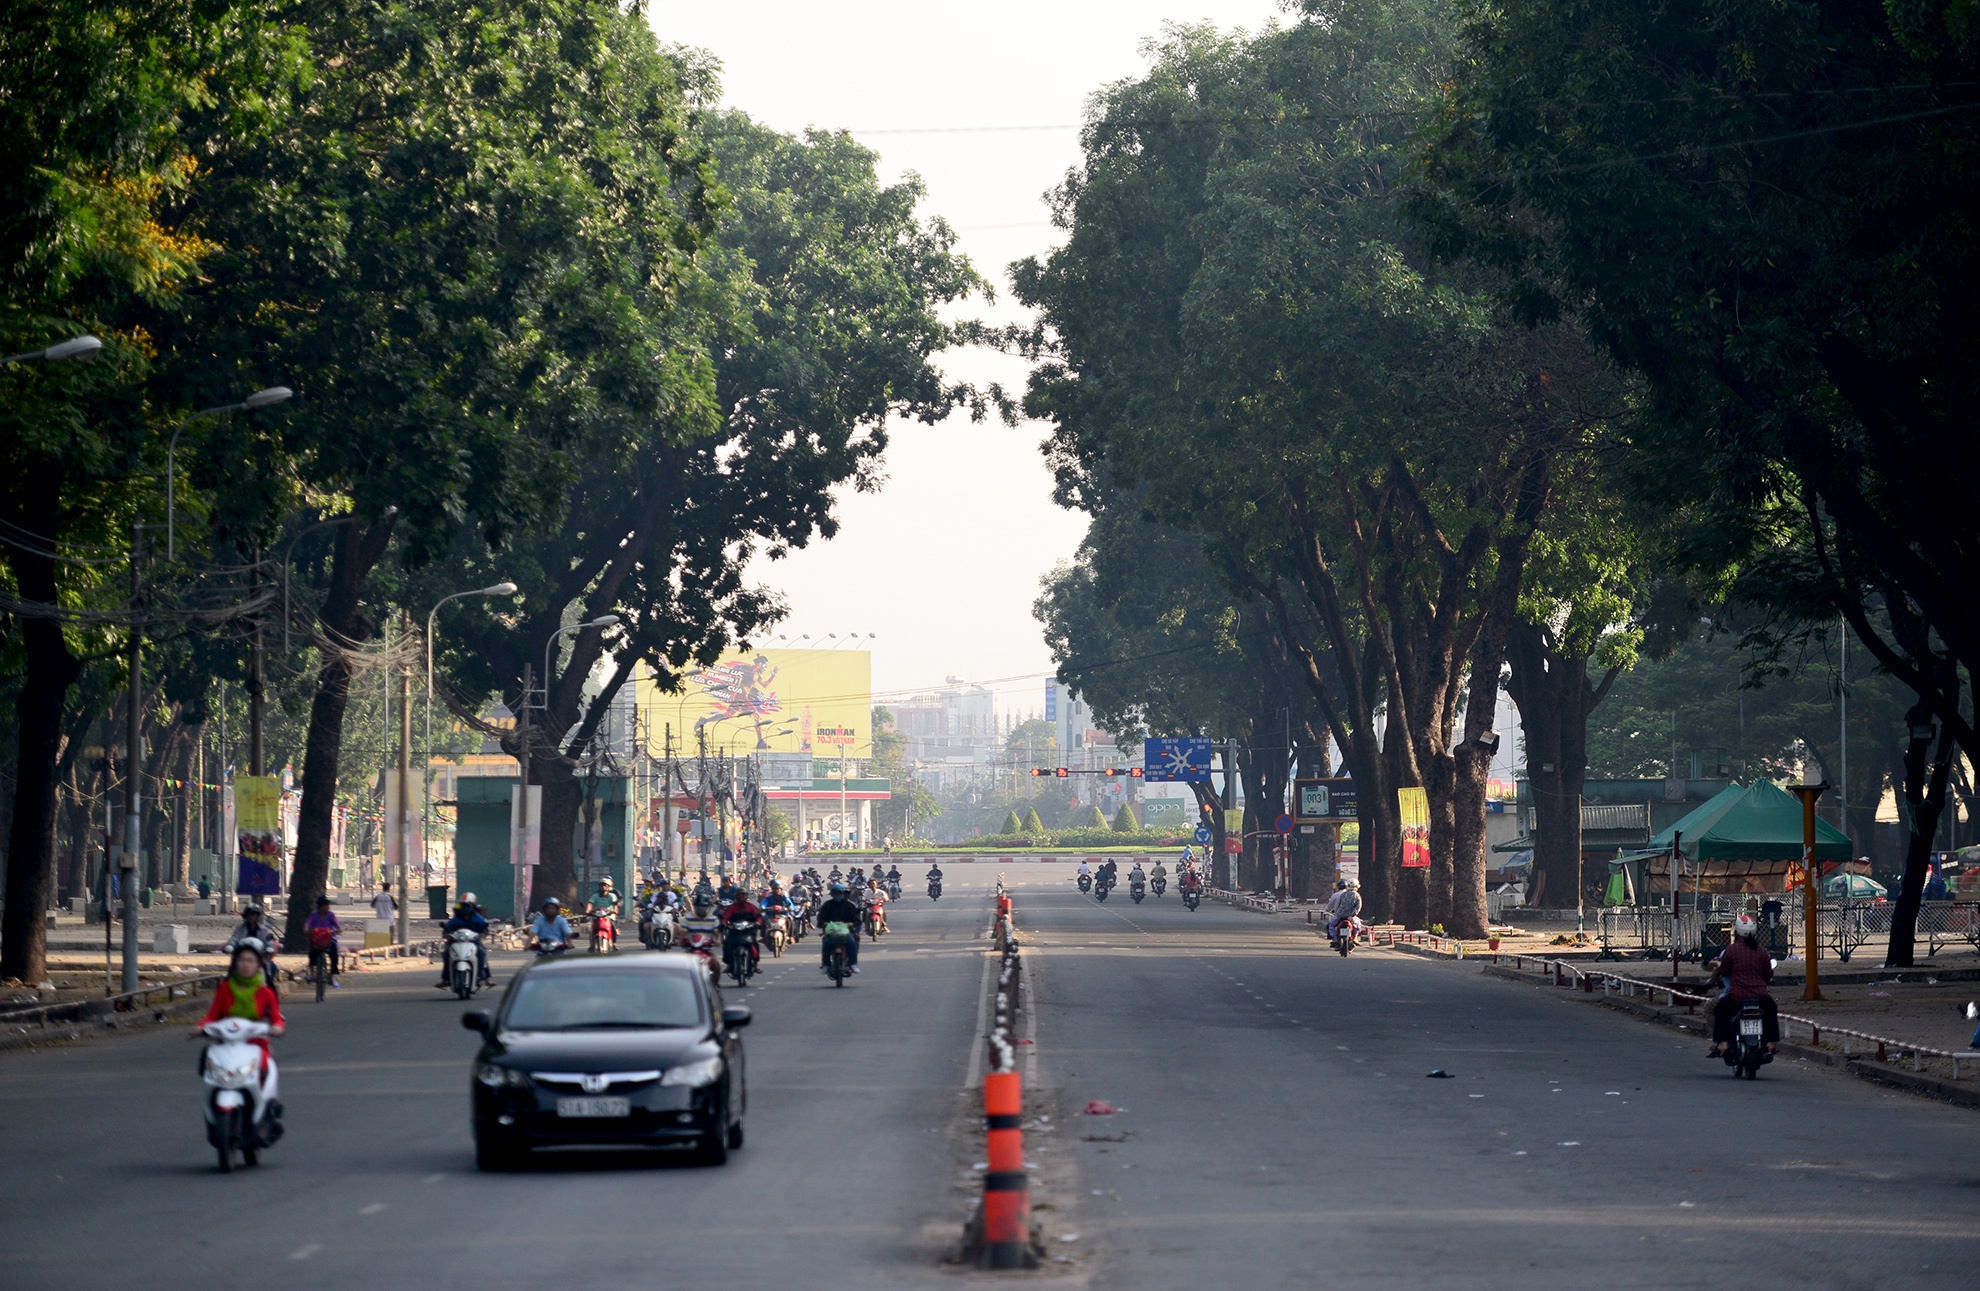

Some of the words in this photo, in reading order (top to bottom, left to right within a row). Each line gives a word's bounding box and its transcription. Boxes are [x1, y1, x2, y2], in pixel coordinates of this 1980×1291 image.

[816, 725, 855, 736] IRONMAN
[816, 735, 832, 744] 70.3
[1132, 768, 1142, 777] 35
